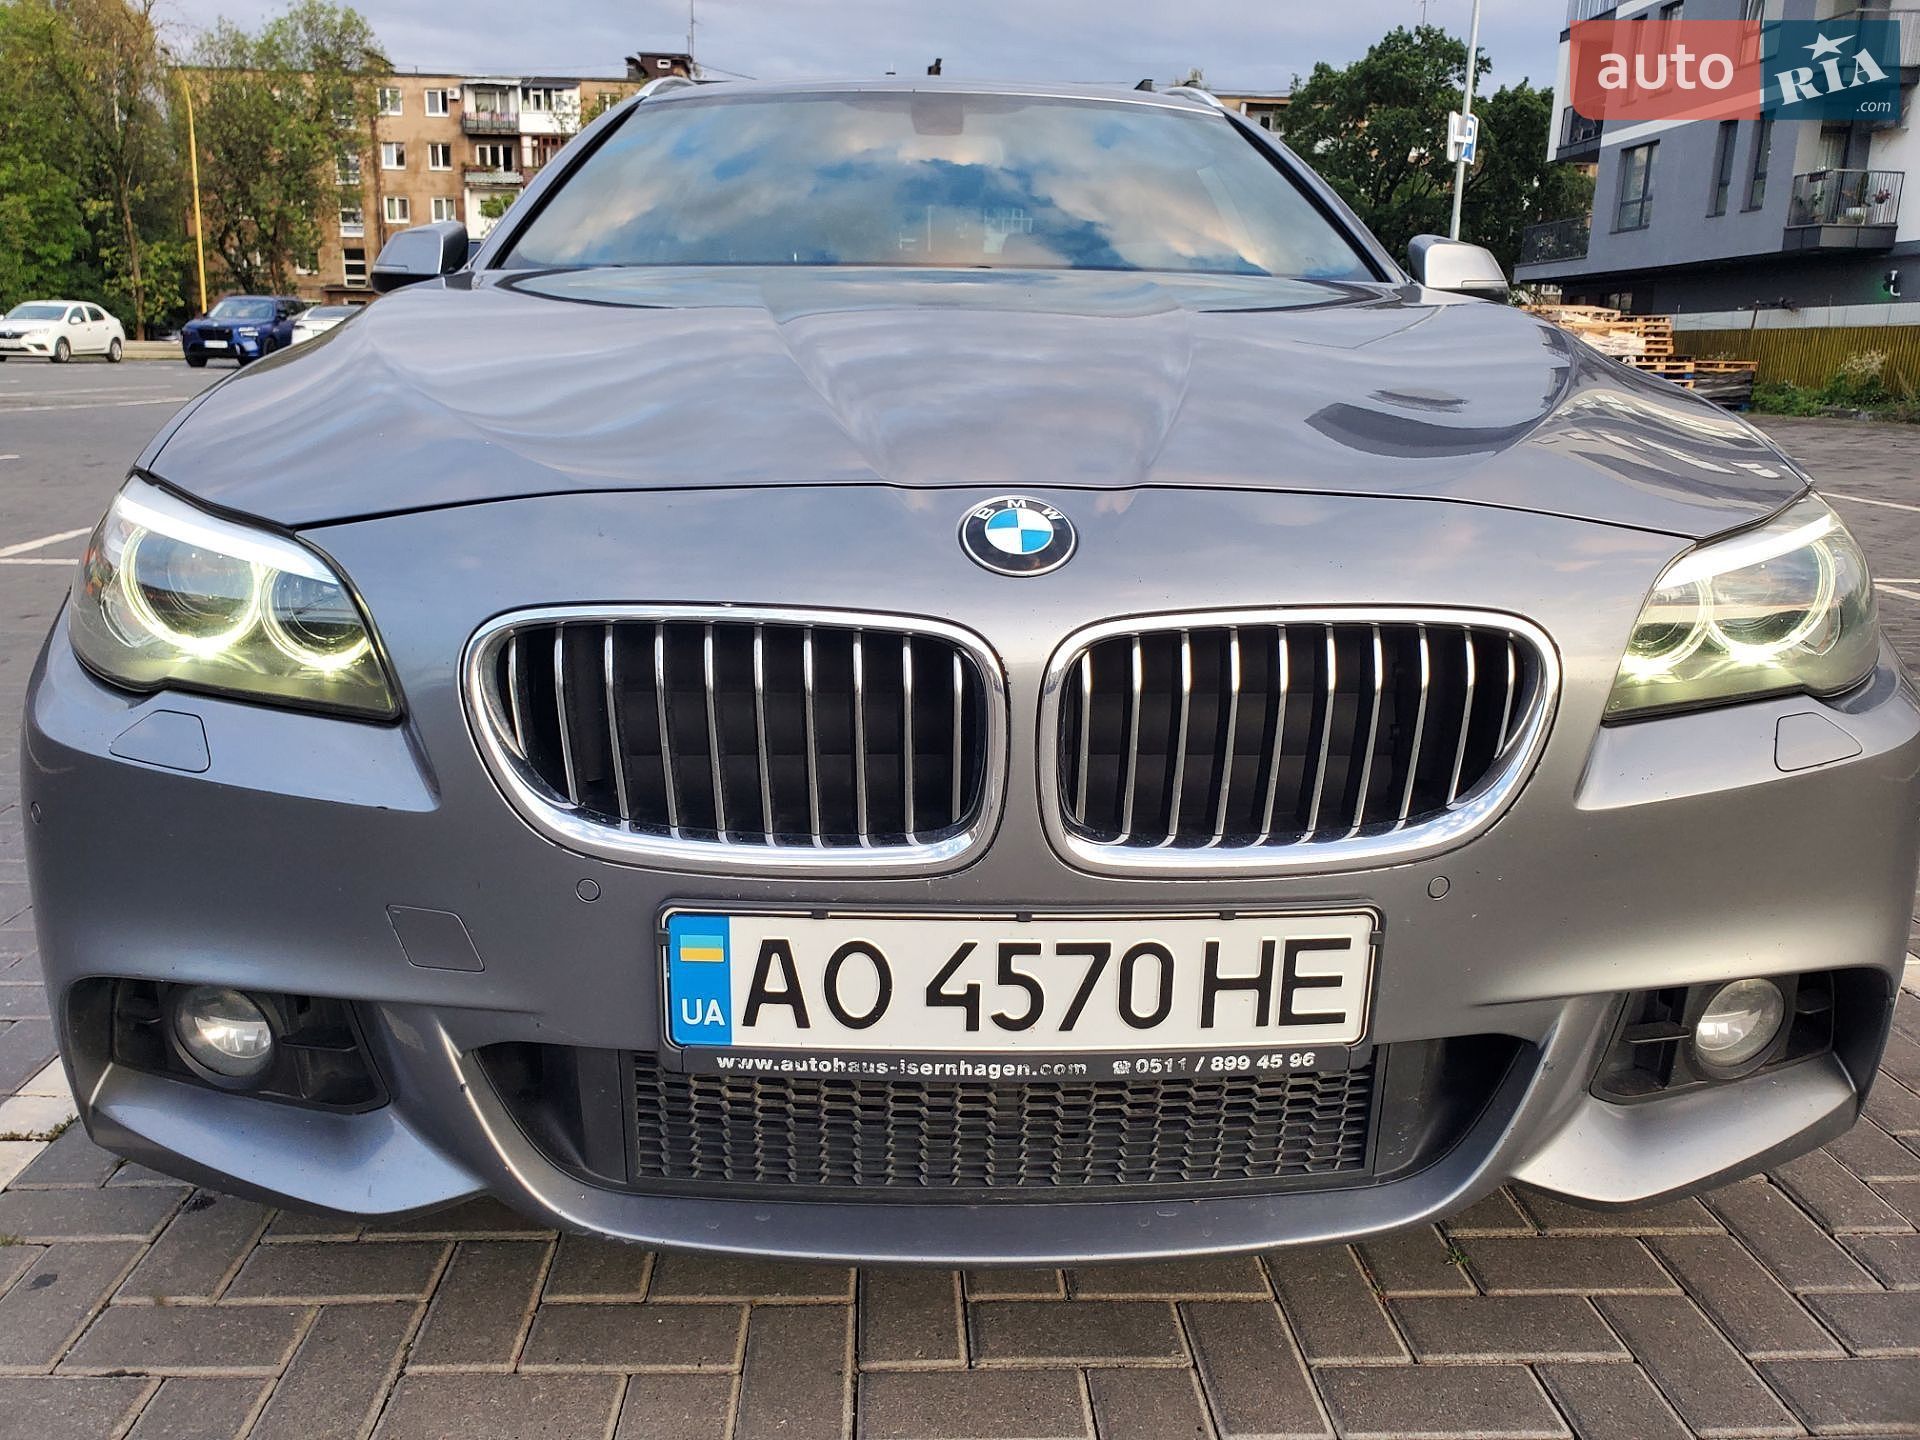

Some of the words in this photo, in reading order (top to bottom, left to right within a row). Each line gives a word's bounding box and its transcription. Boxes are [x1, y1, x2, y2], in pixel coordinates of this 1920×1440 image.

[974, 499, 1064, 520] BMW
[742, 938, 893, 1029] AO
[925, 941, 1173, 1032] 4570
[1201, 936, 1352, 1029] HE
[681, 999, 726, 1027] UA
[716, 1056, 1087, 1080] www.autohaus-isernhagen.com
[1135, 1057, 1187, 1074] 0511
[1210, 1055, 1251, 1072] 899
[1256, 1053, 1283, 1069] 45
[1289, 1051, 1316, 1067] 96
